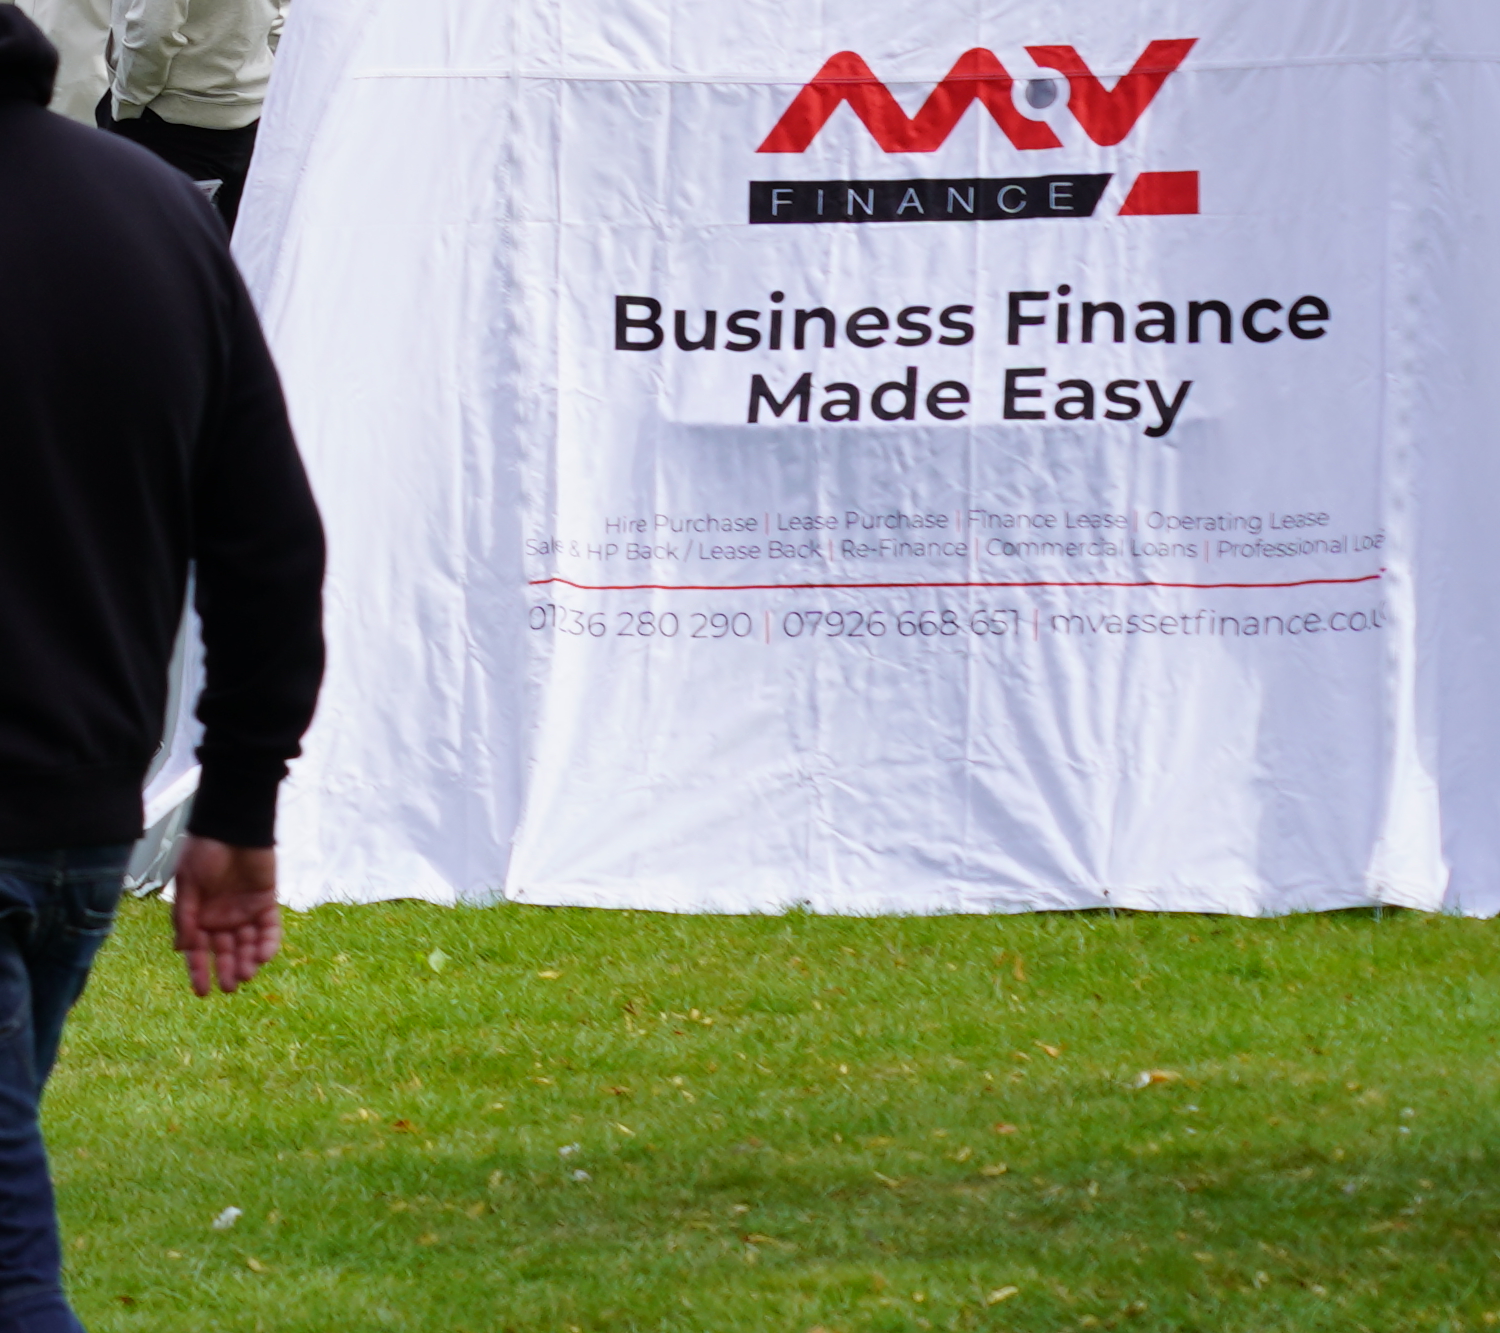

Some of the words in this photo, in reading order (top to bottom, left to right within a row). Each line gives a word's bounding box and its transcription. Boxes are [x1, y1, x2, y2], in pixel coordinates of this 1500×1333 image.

[771, 181, 1075, 216] FINANCE
[614, 290, 975, 351] Business
[1007, 285, 1330, 345] Finance
[747, 366, 970, 424] Made
[1002, 367, 1193, 438] Easy
[605, 516, 647, 534] Hire
[655, 513, 759, 533] Purchase
[777, 512, 839, 531] Lease
[845, 510, 949, 531] Purchase
[968, 509, 1057, 530] Finance
[1065, 510, 1128, 530] Lease
[1146, 511, 1263, 534] Operating
[1269, 511, 1330, 531] Lease
[587, 543, 618, 562] HP
[626, 541, 680, 561] Back
[700, 540, 761, 561] Lease
[769, 539, 823, 560] Back
[842, 538, 968, 559] Re-Finance
[986, 537, 1124, 558] Commercial
[1133, 538, 1198, 559] Loans
[1217, 534, 1347, 559] Professional
[616, 612, 679, 637] 280
[689, 611, 753, 638] 290
[783, 609, 887, 637] 07926
[897, 609, 958, 636] 668
[969, 609, 1020, 636] 651
